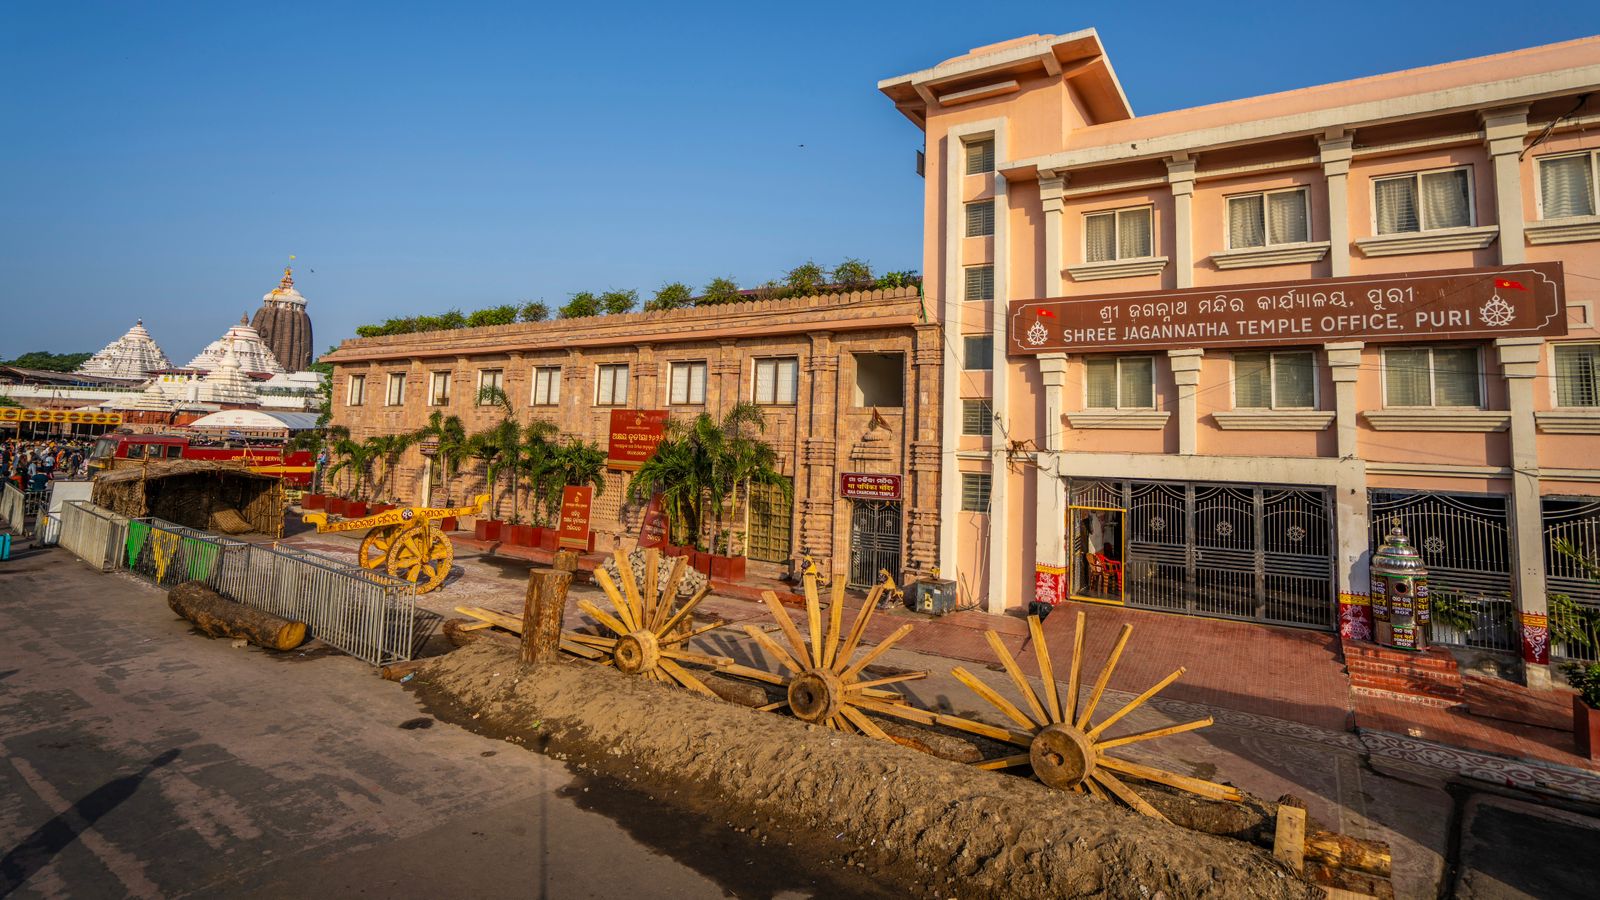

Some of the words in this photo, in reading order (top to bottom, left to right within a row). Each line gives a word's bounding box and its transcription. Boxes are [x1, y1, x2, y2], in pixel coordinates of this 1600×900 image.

[1100, 305, 1119, 324] ଶ୍ରୀ
[1129, 301, 1187, 323] ଜଗନ୍ନାଥ
[1199, 295, 1244, 314] ମନ୍ଦିର
[1367, 287, 1414, 310] ପୁରୀ
[1063, 327, 1117, 343] SHREE
[1122, 322, 1229, 341] JAGANNATHA
[1236, 317, 1313, 336] TEMPLE
[1320, 313, 1404, 333] OFFICE,
[1415, 309, 1471, 328] PURI
